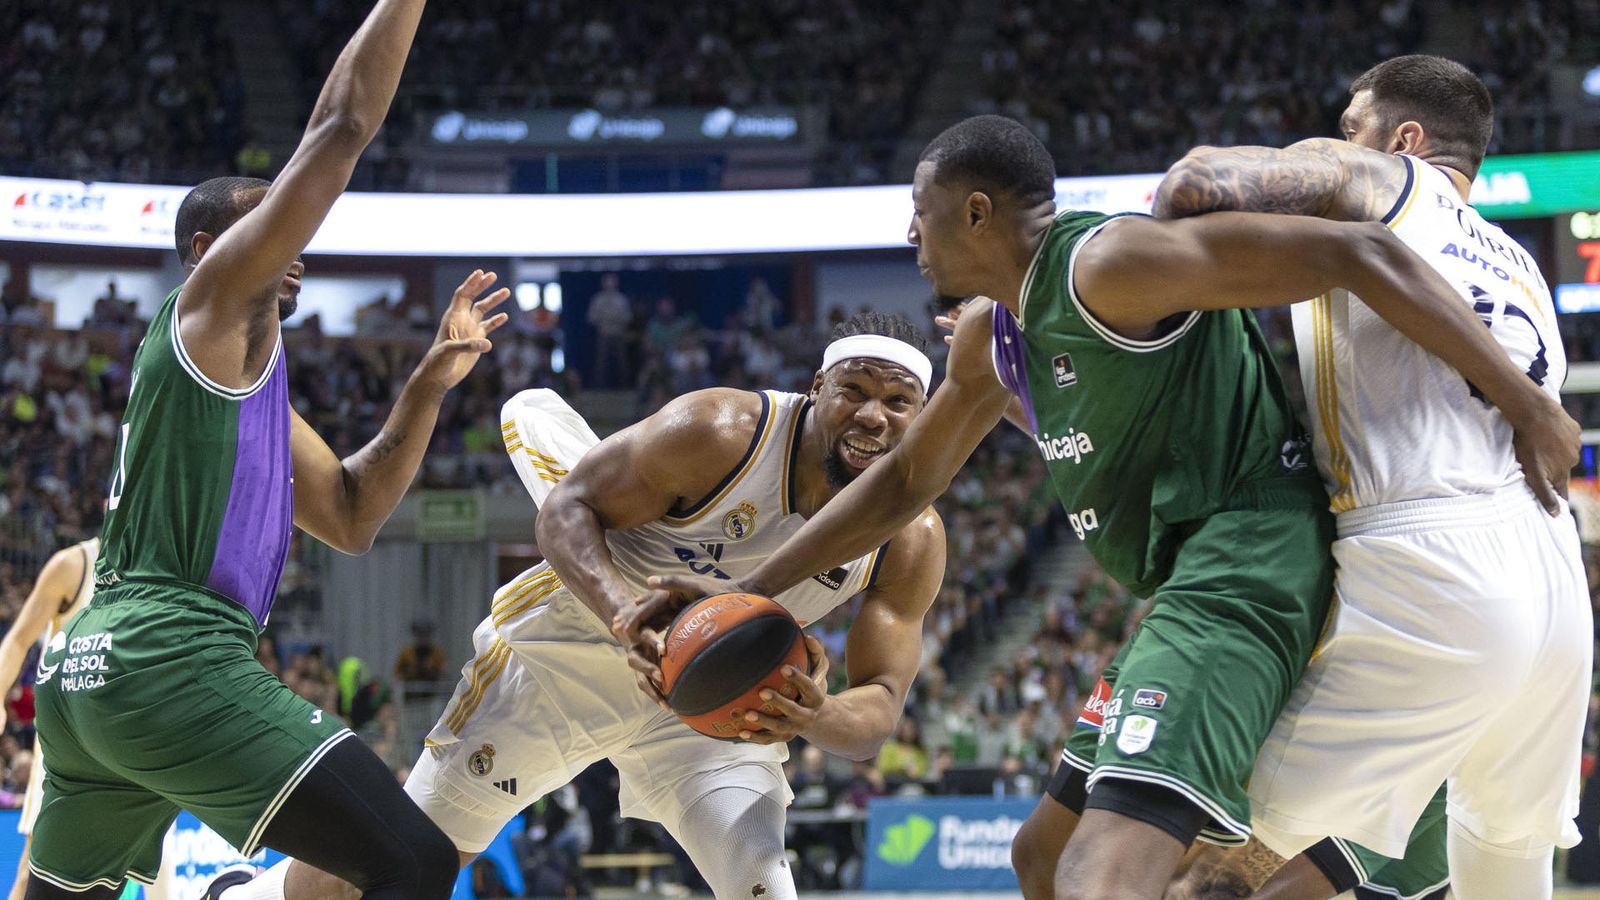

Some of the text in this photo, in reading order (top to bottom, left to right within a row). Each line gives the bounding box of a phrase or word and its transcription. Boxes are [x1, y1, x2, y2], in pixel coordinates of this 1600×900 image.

[1034, 427, 1094, 465] nicaja
[818, 573, 840, 589] desa
[68, 632, 113, 655] COSTA
[62, 654, 109, 674] DEL SOL
[61, 673, 106, 693] MÁLAGA
[1136, 696, 1156, 706] acb
